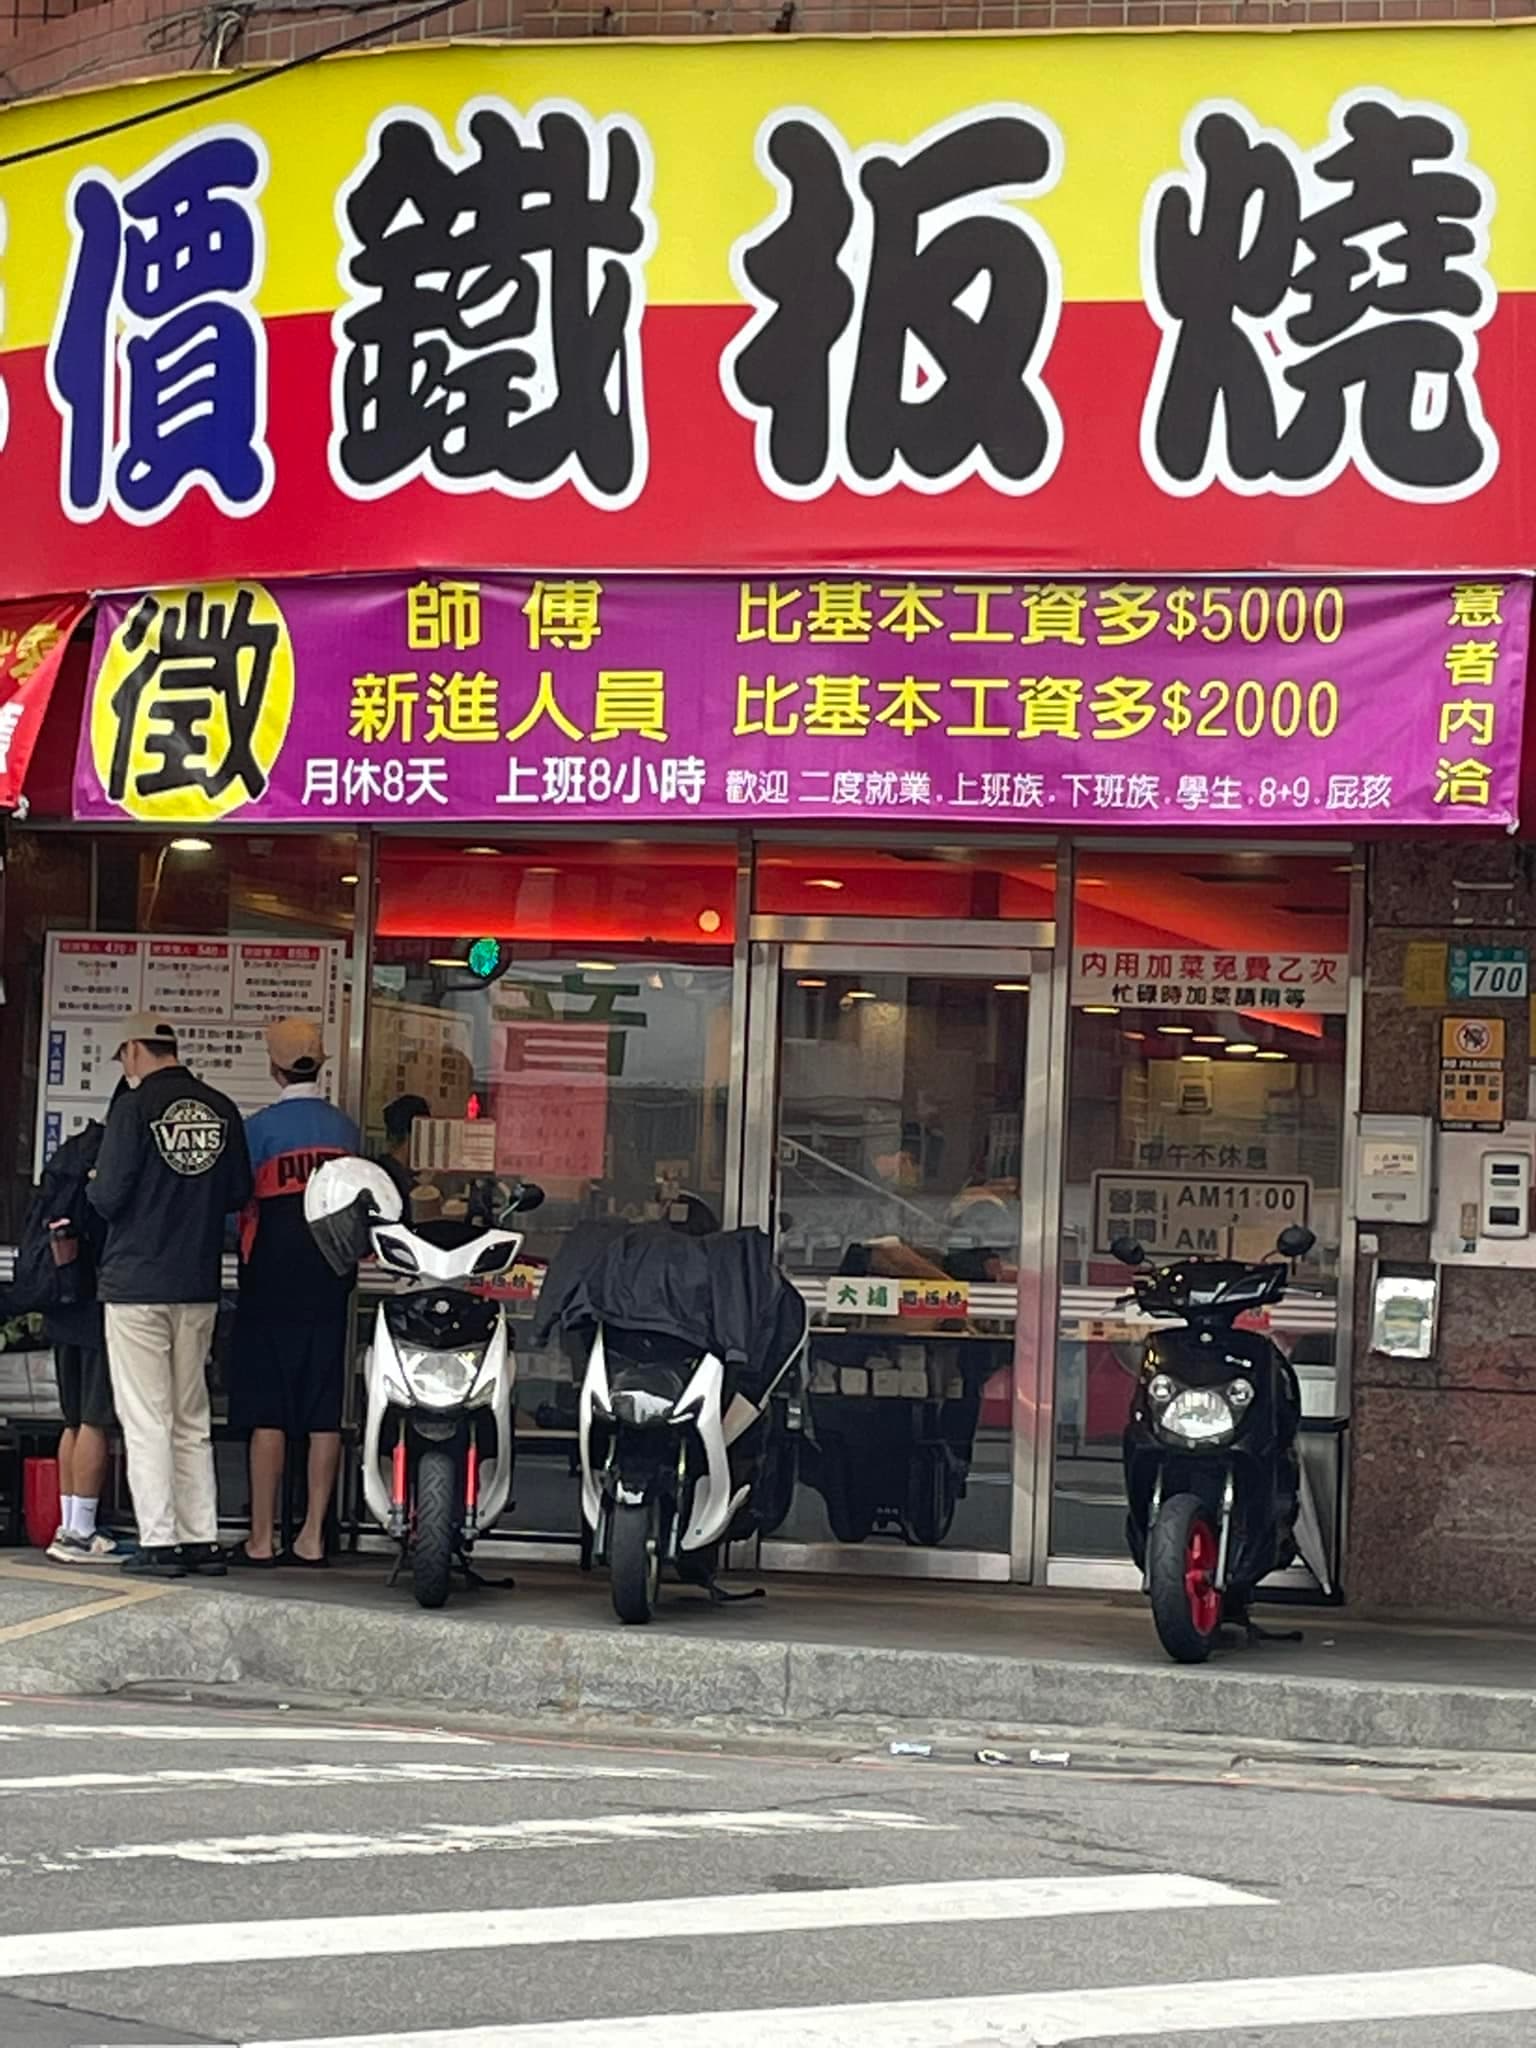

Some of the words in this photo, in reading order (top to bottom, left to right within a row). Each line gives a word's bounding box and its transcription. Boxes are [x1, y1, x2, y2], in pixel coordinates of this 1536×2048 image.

[406, 580, 603, 651] 師傅
[736, 581, 1345, 646] 比基本工資多$5000
[349, 670, 669, 743] 新進人員
[732, 674, 1340, 740] 比基本工資多$2000
[1433, 584, 1505, 805] 意者內洽
[301, 758, 449, 806] 月休8天
[496, 756, 706, 806] 上班8小時
[725, 769, 790, 803] 歡迎
[1082, 952, 1338, 984] 內用加菜免費乙次
[1473, 966, 1522, 993] 700
[160, 1123, 221, 1151] VANS
